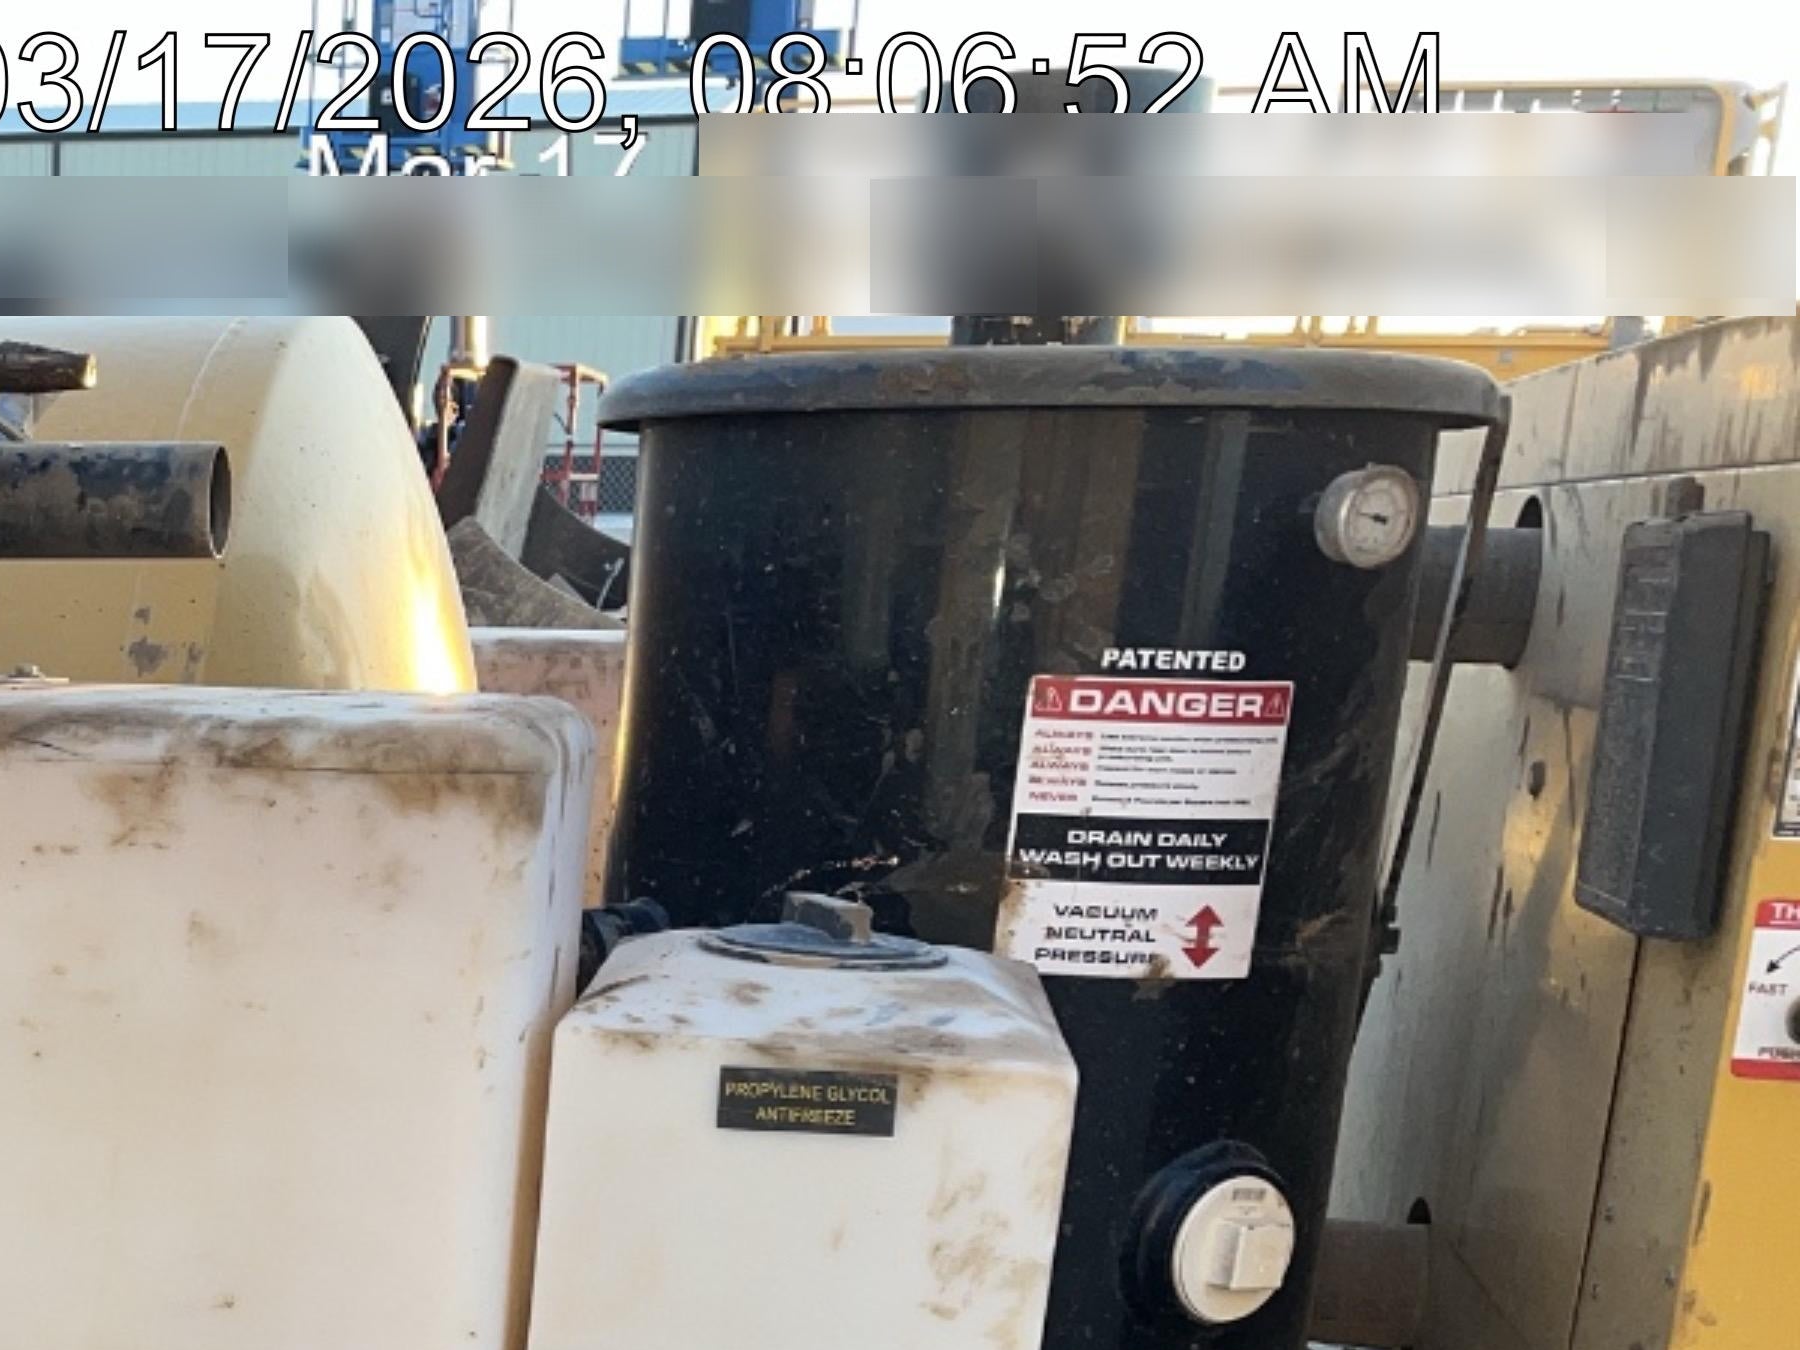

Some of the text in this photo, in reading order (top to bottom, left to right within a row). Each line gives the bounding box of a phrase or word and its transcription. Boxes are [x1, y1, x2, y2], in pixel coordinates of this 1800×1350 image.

[1101, 648, 1246, 672] PATENTED
[1068, 688, 1264, 719] DANGER
[1067, 829, 1228, 848] DRAIN DAILY
[1018, 848, 1261, 872] WASH OUT WEEKLY
[1053, 903, 1159, 921] VACUUM
[1045, 926, 1156, 944] NEUTRAL
[1748, 981, 1789, 996] FAST
[725, 1081, 891, 1106] PROPYLENE GLYCOL
[755, 1106, 857, 1127] ANTIFREEZE
